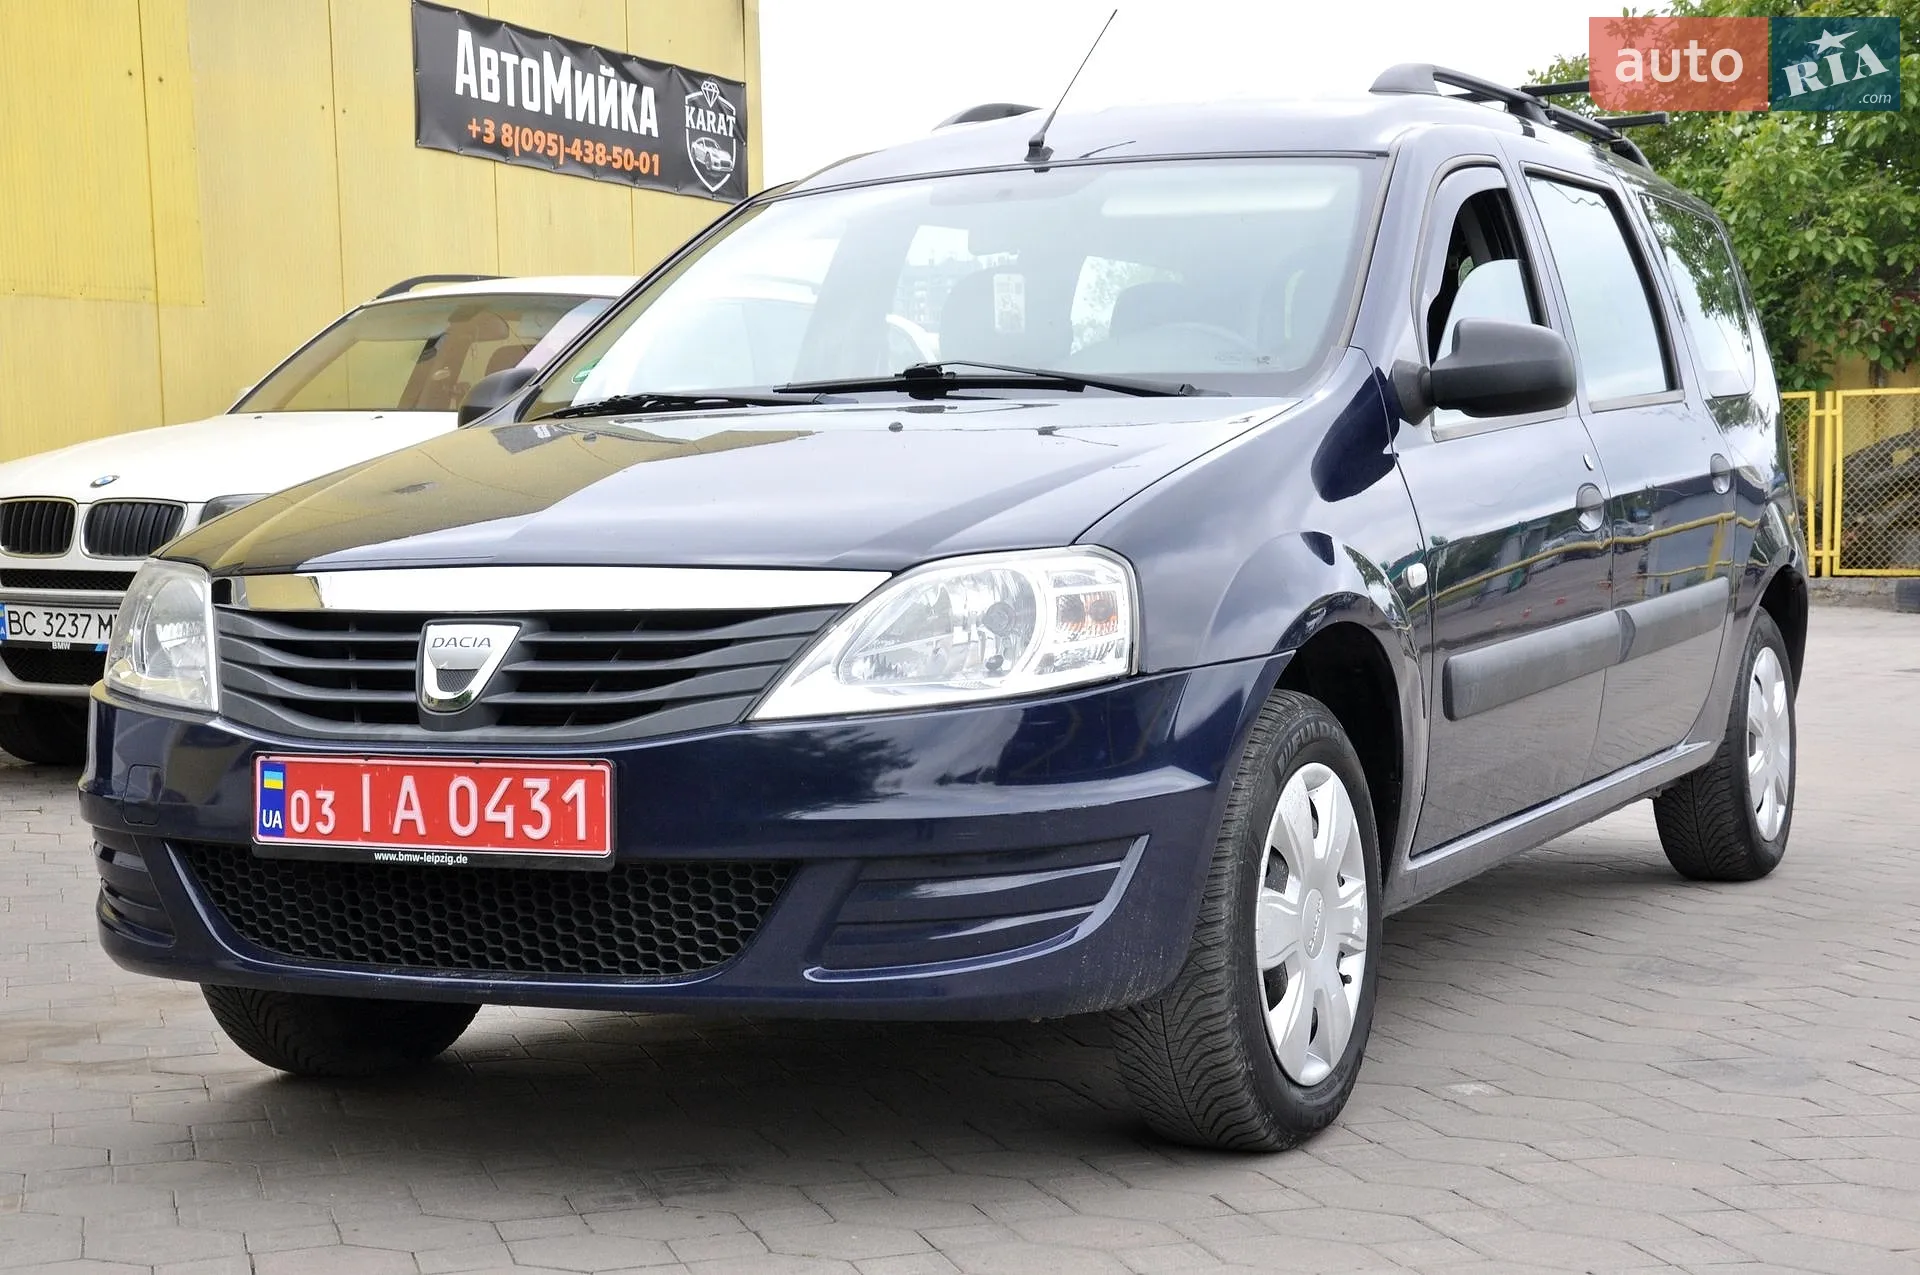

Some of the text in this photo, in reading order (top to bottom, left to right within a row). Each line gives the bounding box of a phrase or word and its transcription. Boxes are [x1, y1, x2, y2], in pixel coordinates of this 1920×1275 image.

[685, 105, 736, 137] KARAT
[468, 117, 660, 176] +3 8(095)-438-50-01
[8, 610, 118, 640] BC 3237 M
[52, 641, 71, 650] BMW
[431, 636, 492, 649] DACIA
[262, 809, 283, 829] UA
[290, 789, 336, 835] 03
[448, 775, 587, 841] 0431
[374, 852, 468, 866] www.bmw-leipzig.de
